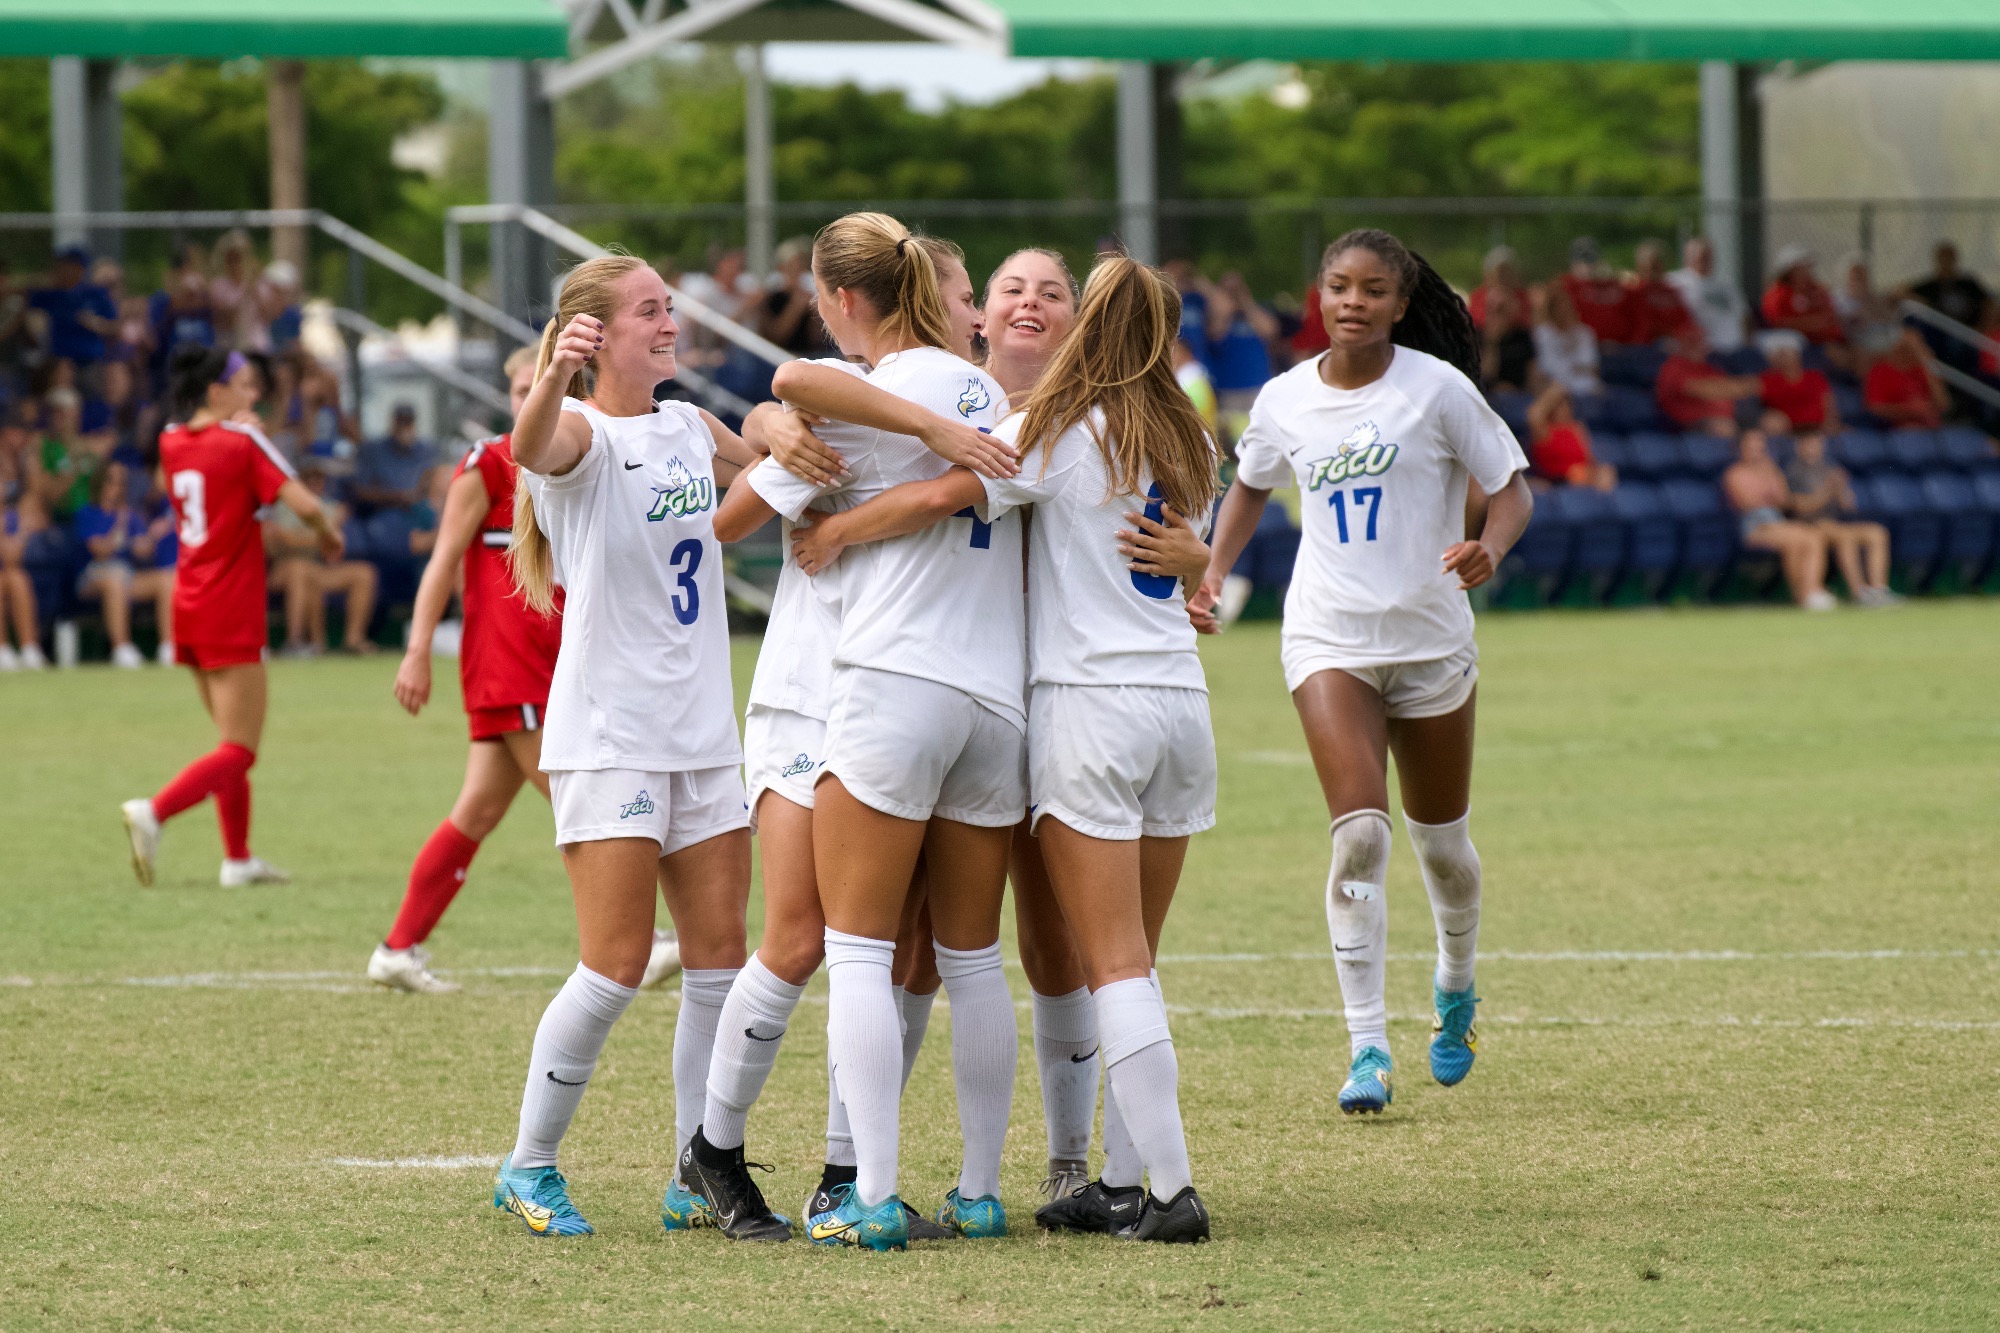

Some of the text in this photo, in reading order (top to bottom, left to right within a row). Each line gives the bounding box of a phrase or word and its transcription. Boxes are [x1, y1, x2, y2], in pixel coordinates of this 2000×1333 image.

[1306, 443, 1399, 492] FGCU
[173, 469, 208, 548] 3
[647, 476, 712, 523] FGCU
[1328, 486, 1382, 544] 17
[670, 538, 703, 626] 3
[781, 761, 815, 778] FGCU
[620, 801, 655, 819] FGCU
